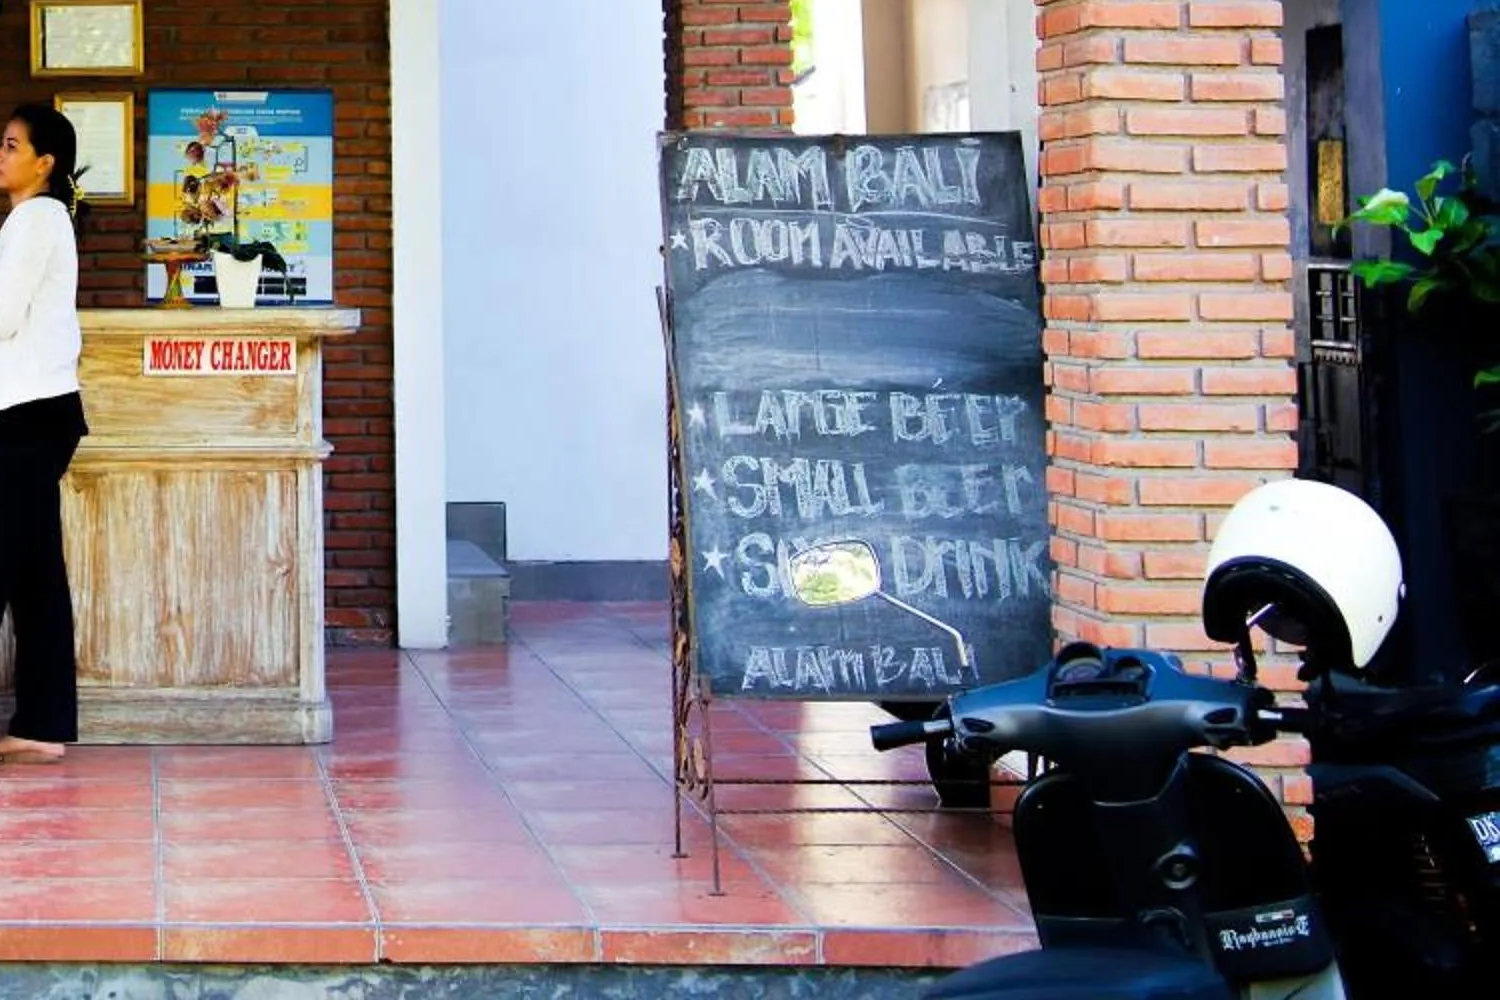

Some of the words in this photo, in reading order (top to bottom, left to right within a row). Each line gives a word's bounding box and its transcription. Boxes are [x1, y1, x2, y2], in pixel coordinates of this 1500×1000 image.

[677, 145, 835, 210] ALAM
[845, 138, 982, 211] BALI
[687, 215, 823, 270] ROOM
[830, 224, 1037, 273] AVAILABLE
[149, 340, 205, 371] MONEY
[209, 340, 292, 371] CHANGER
[721, 455, 884, 519] SMALL
